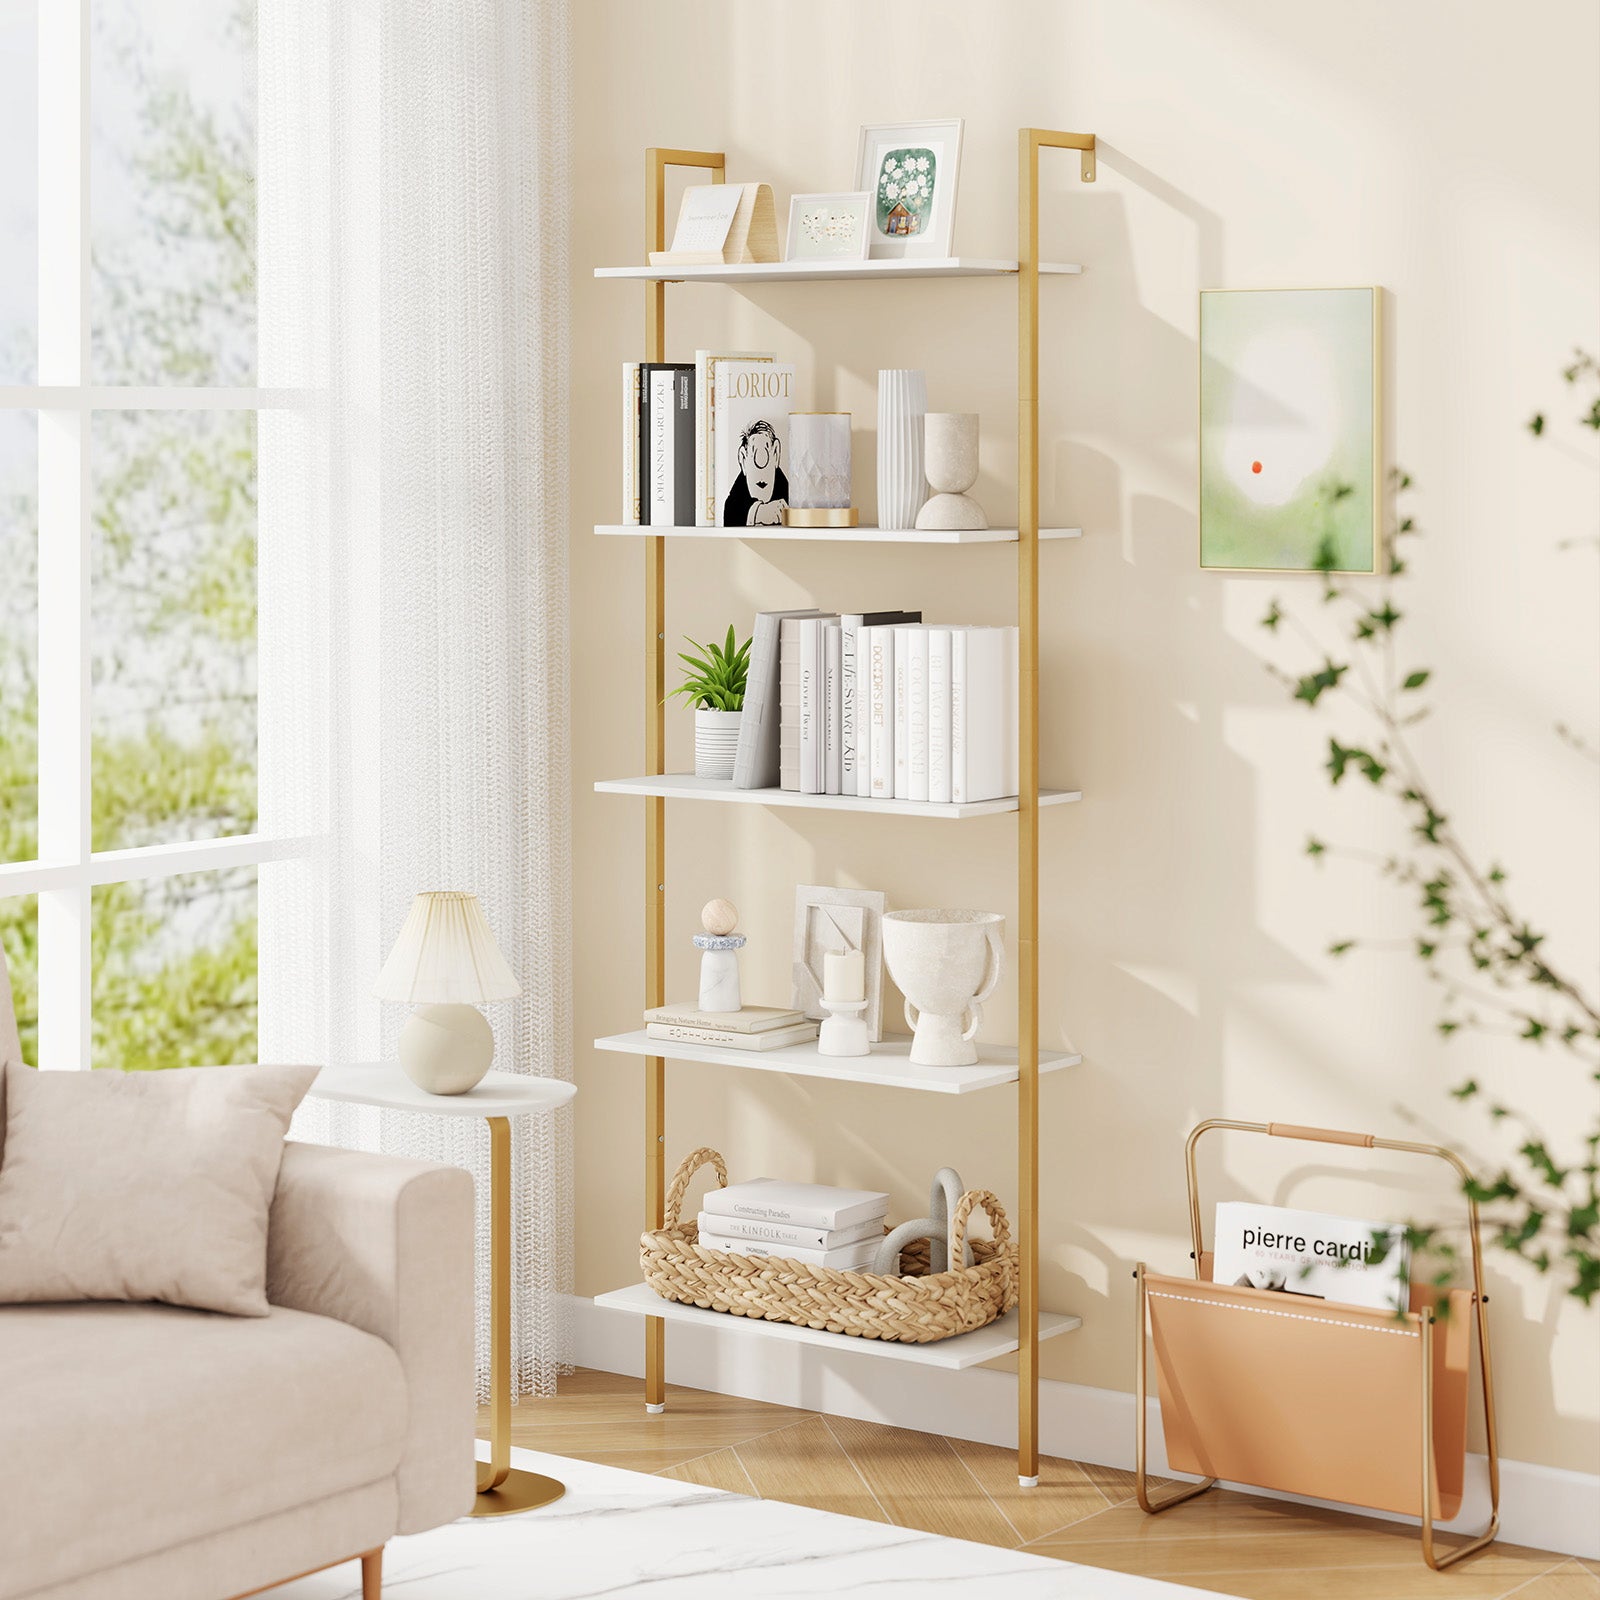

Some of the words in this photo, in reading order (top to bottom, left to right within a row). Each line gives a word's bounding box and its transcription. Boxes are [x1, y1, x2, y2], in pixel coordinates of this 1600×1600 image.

[727, 372, 792, 399] LORIOT
[656, 439, 665, 503] JOHANNES
[873, 703, 883, 727] DIET
[655, 1014, 677, 1024] Bringing
[679, 1016, 696, 1025] Nature
[734, 1204, 767, 1218] Constructing
[741, 1226, 782, 1240] KINFOLK
[782, 1232, 798, 1240] TABLE
[1243, 1226, 1306, 1252] pierre
[1313, 1239, 1370, 1261] cardi
[1269, 1252, 1296, 1263] YEARS
[1300, 1256, 1312, 1264] OF
